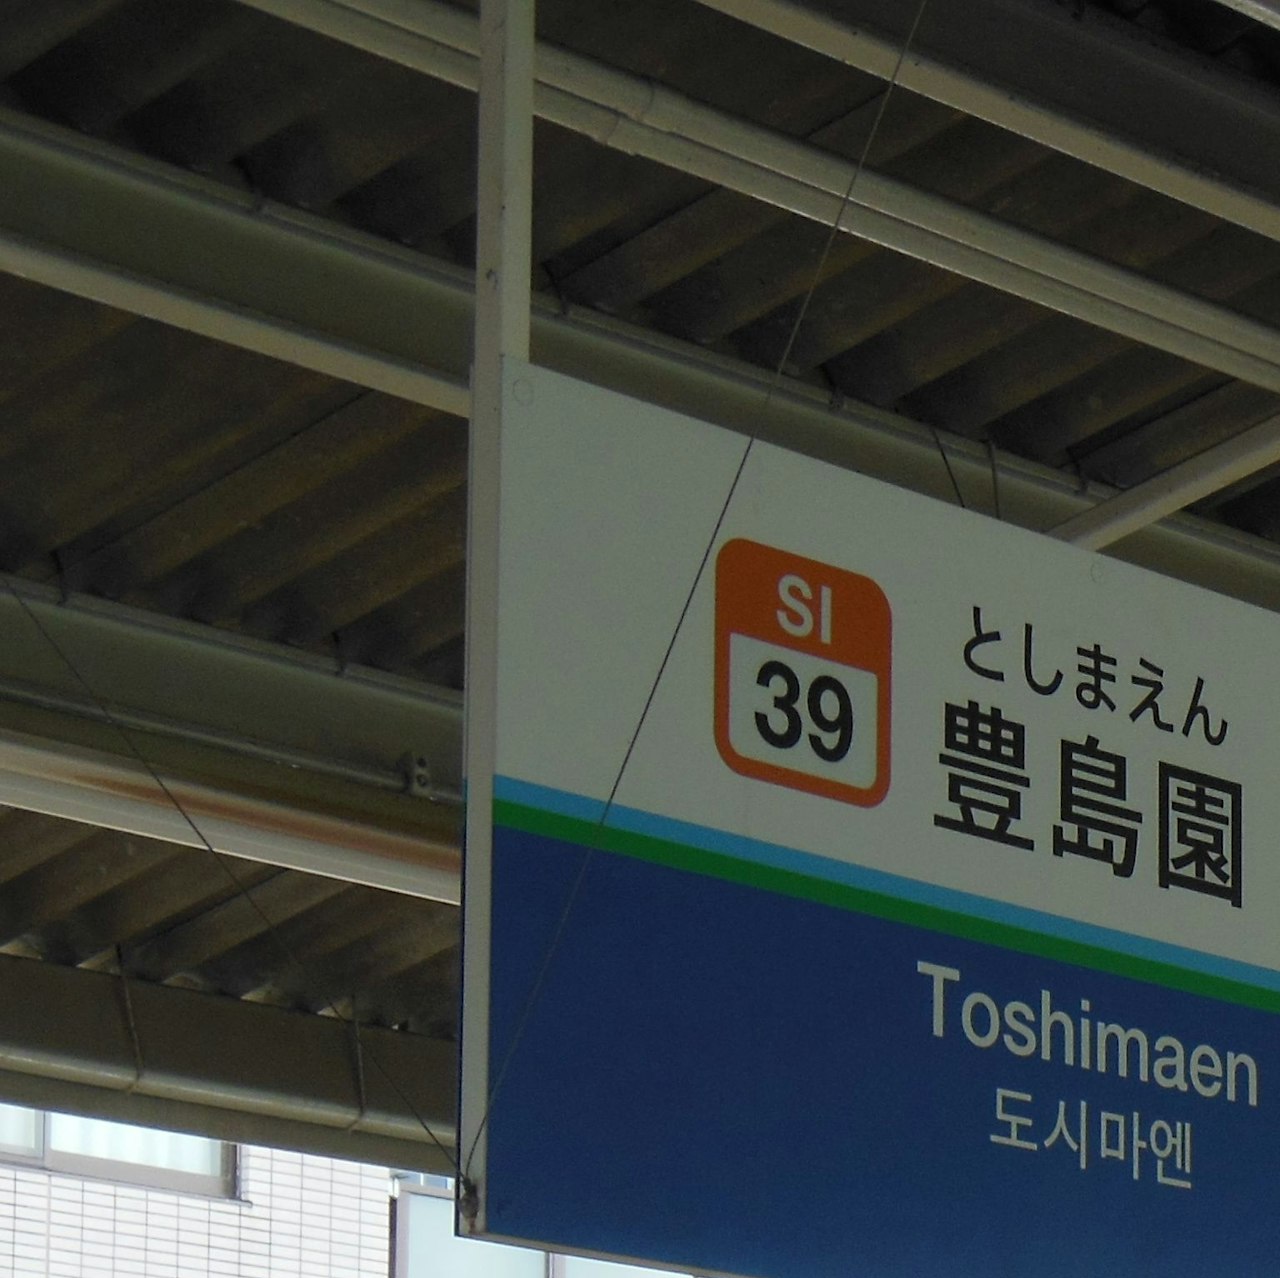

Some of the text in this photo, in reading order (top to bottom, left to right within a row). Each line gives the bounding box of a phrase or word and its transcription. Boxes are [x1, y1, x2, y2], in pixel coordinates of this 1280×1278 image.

[776, 574, 833, 645] SI
[754, 660, 854, 763] 39
[963, 605, 1229, 747] としまえん
[933, 699, 1243, 909] 豊島園
[917, 960, 1258, 1107] Toshimaen
[989, 1087, 1192, 1190] 도시마엔
